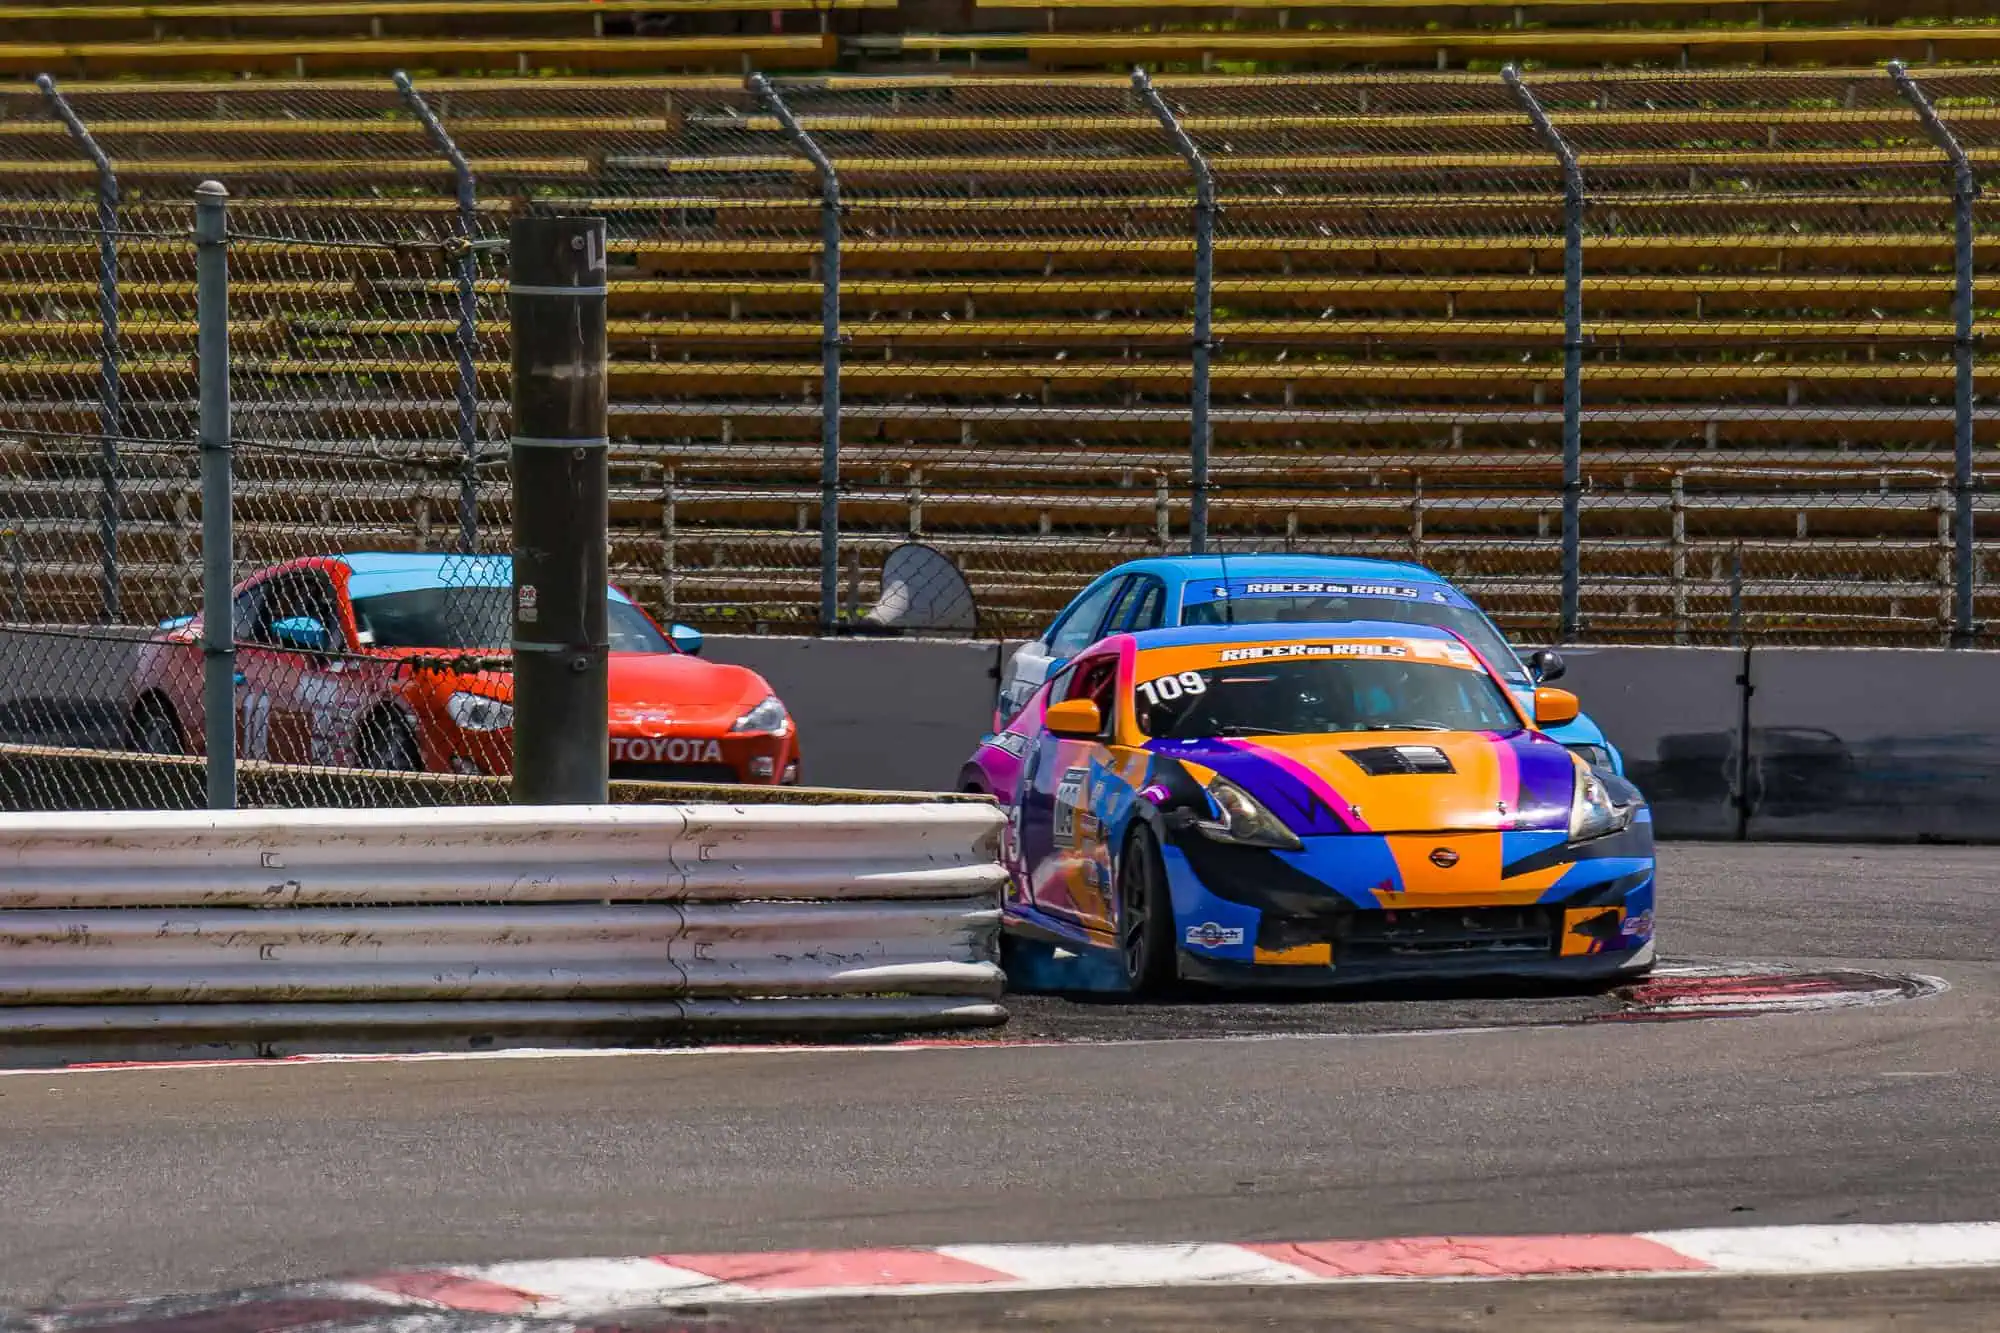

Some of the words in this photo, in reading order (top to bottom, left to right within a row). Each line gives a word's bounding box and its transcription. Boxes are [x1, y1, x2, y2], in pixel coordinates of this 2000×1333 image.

[1247, 583, 1324, 593] RACER
[1351, 585, 1418, 598] RAILS
[1221, 644, 1306, 662] RACER
[1332, 644, 1408, 656] RAILS
[1136, 671, 1207, 705] 109
[610, 738, 723, 762] TOYOTA
